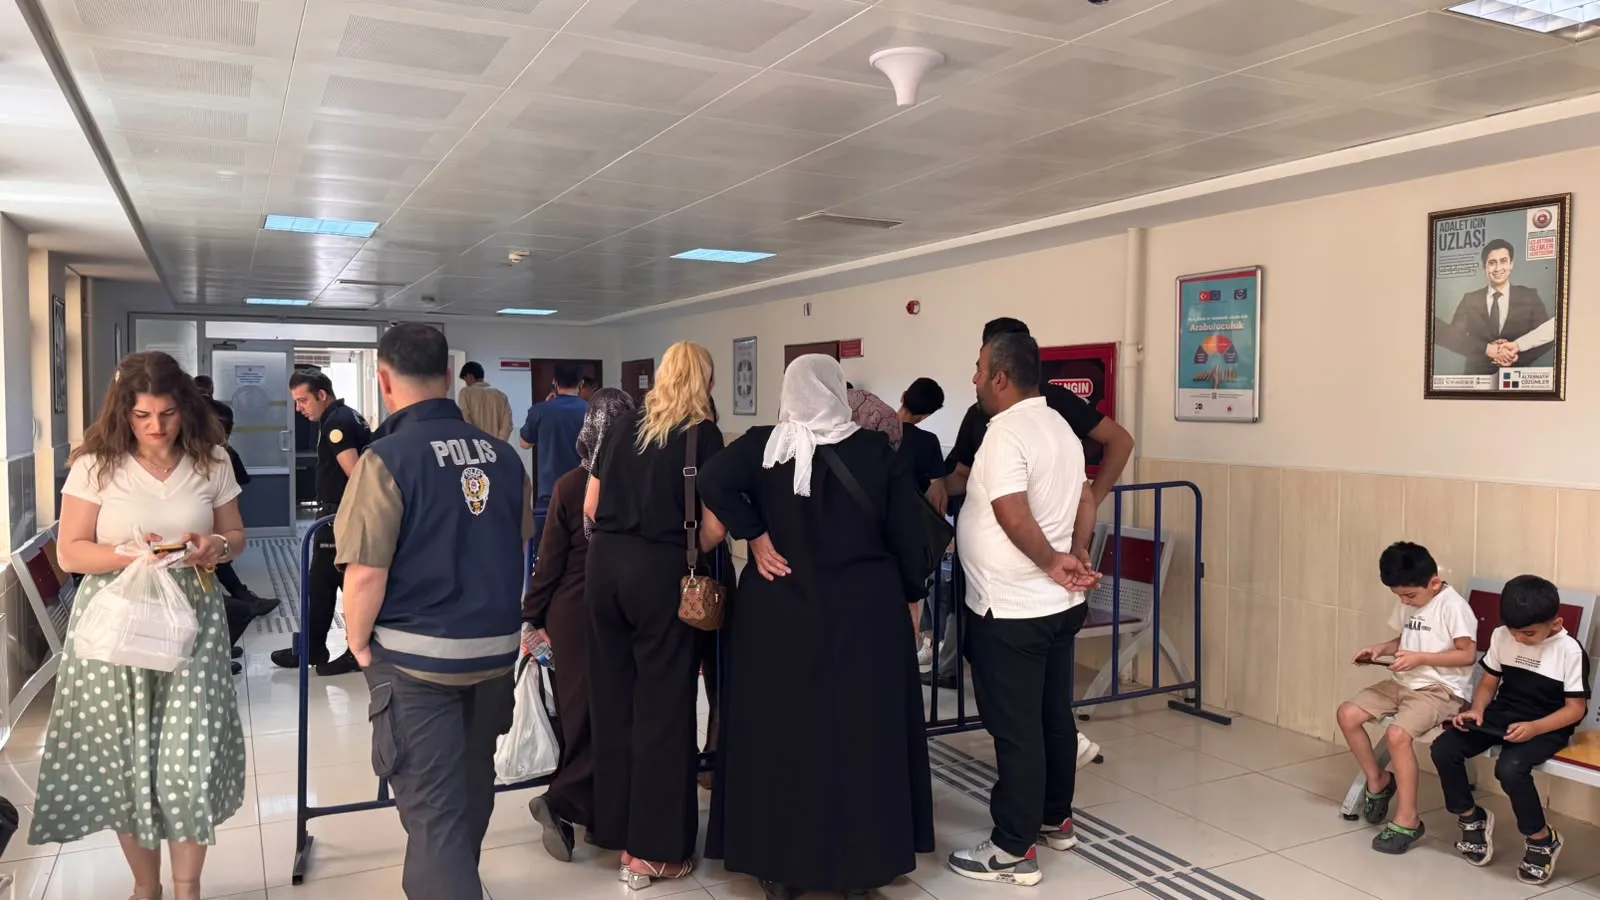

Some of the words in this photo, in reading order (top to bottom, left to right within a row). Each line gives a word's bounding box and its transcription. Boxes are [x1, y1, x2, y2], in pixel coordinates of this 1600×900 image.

[1439, 219, 1468, 233] ADALET
[1188, 320, 1245, 332] Arabuluculuk
[1051, 382, 1090, 394] NGIN
